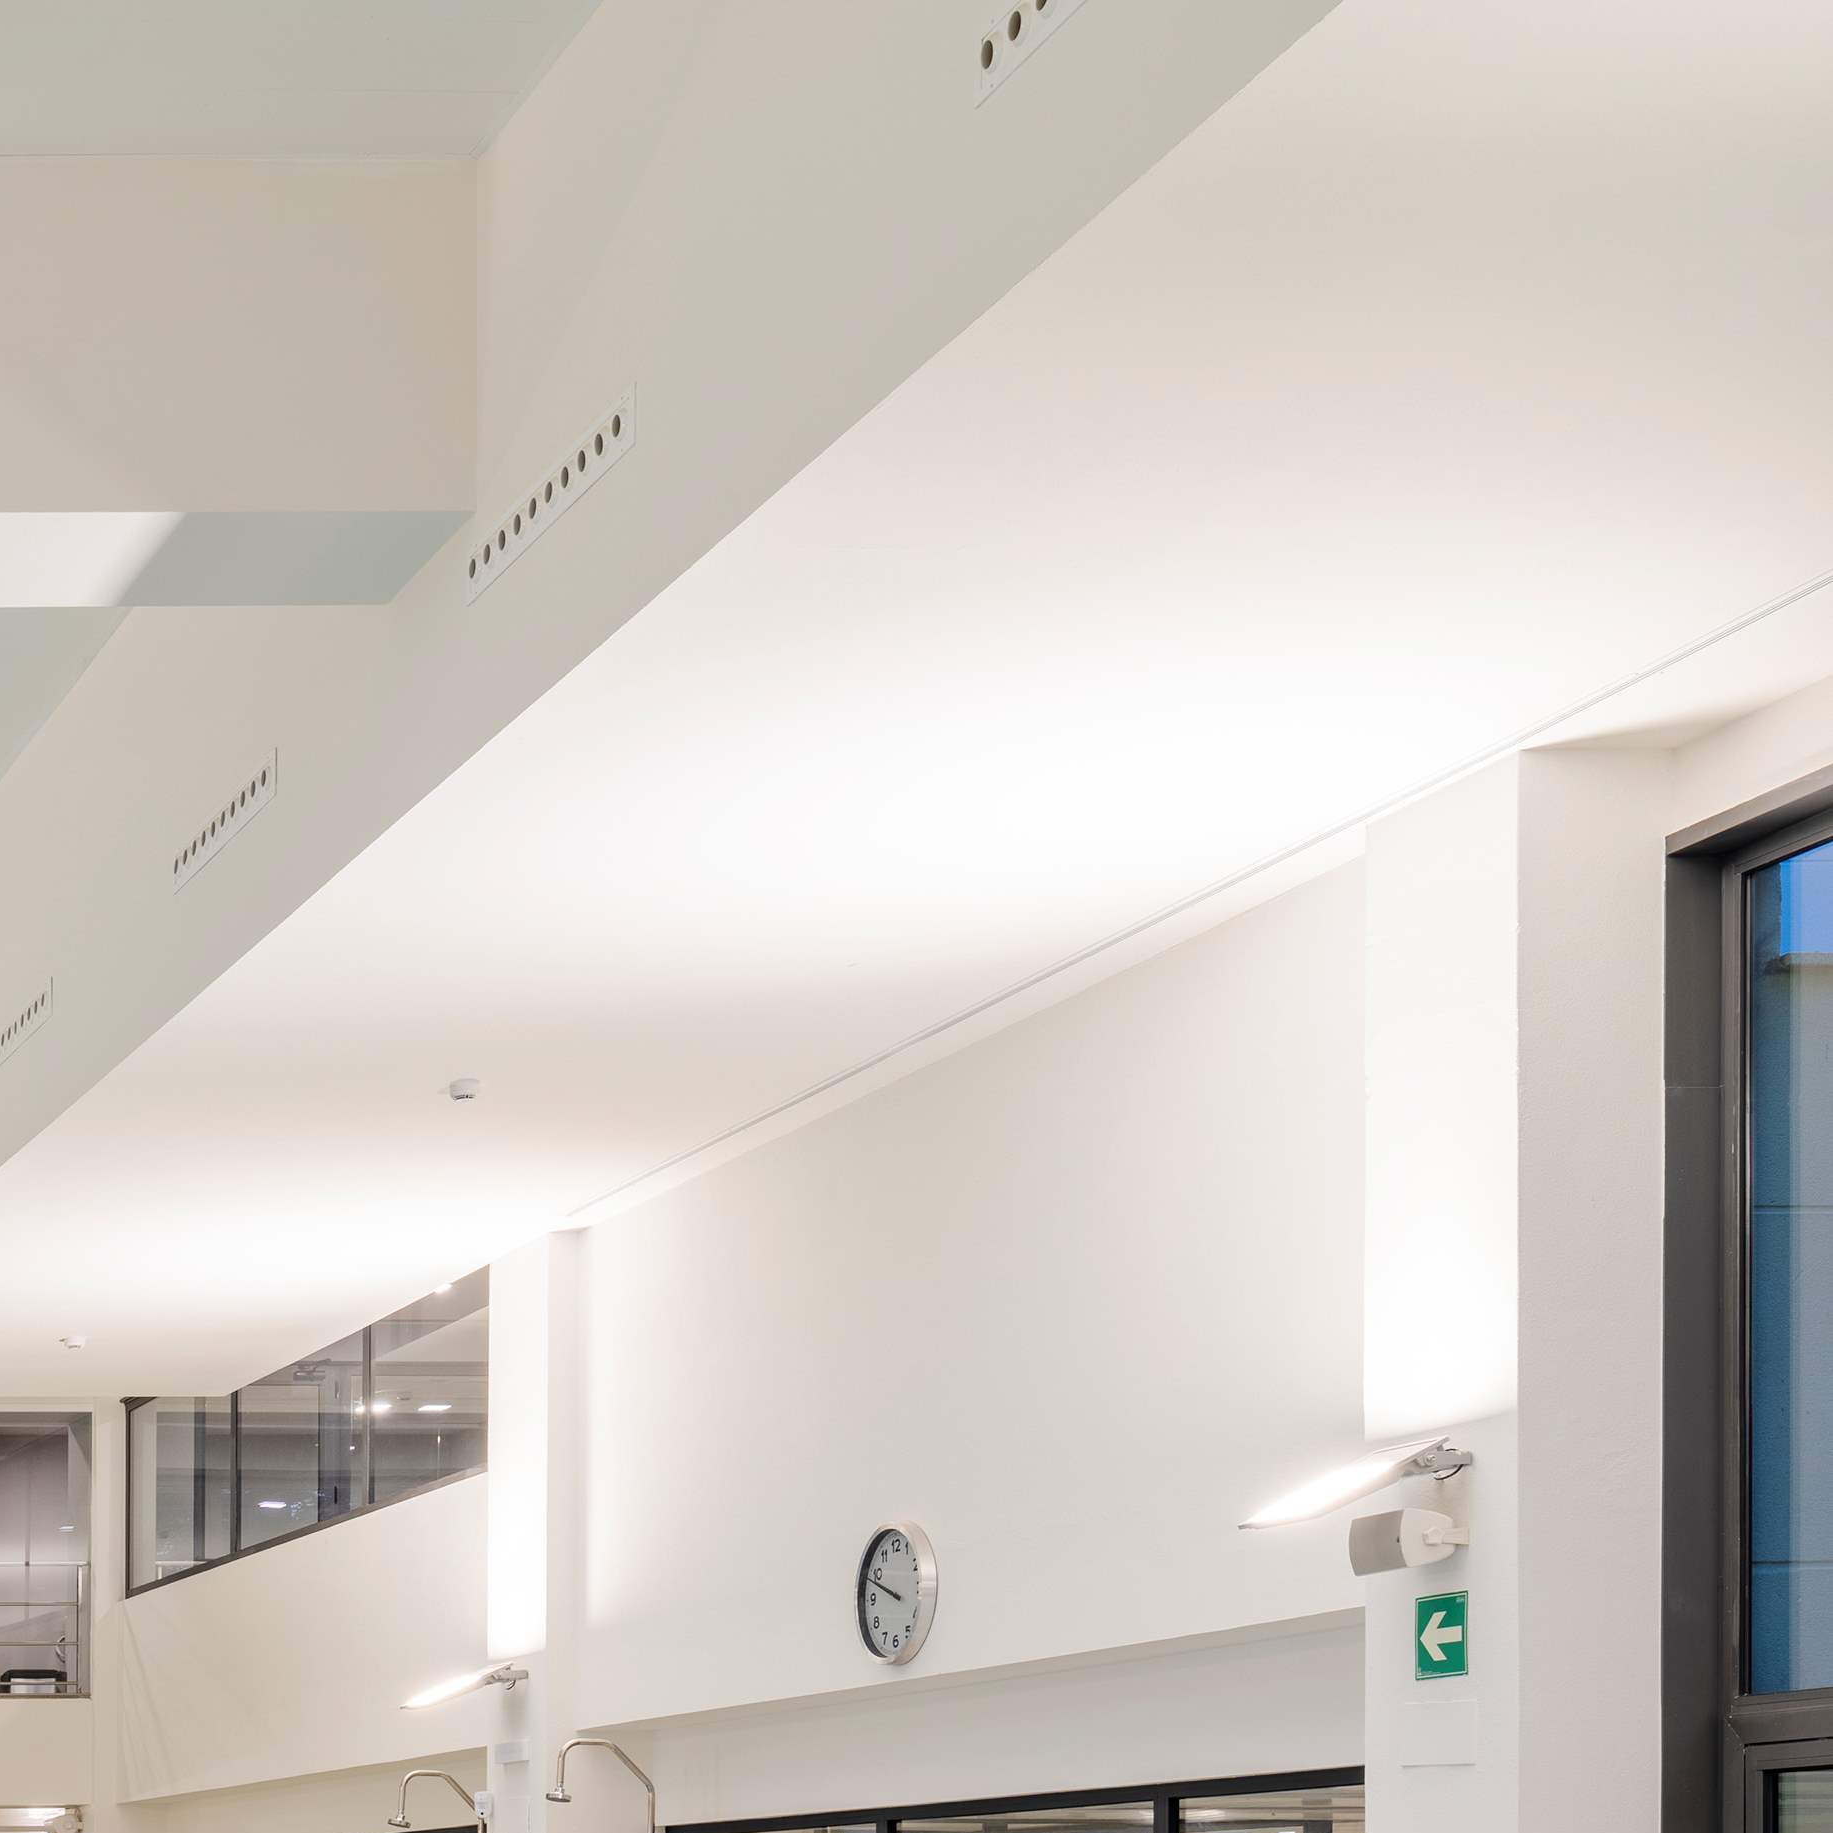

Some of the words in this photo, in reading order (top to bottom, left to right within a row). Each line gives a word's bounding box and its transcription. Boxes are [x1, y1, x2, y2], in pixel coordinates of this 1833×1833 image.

[891, 1539, 901, 1552] 12
[905, 1542, 909, 1554] 1
[881, 1550, 888, 1562] 11
[873, 1568, 882, 1581] 10
[870, 1593, 876, 1605] 9
[874, 1616, 879, 1628] 8
[882, 1632, 888, 1645] 7
[893, 1635, 899, 1648] 6
